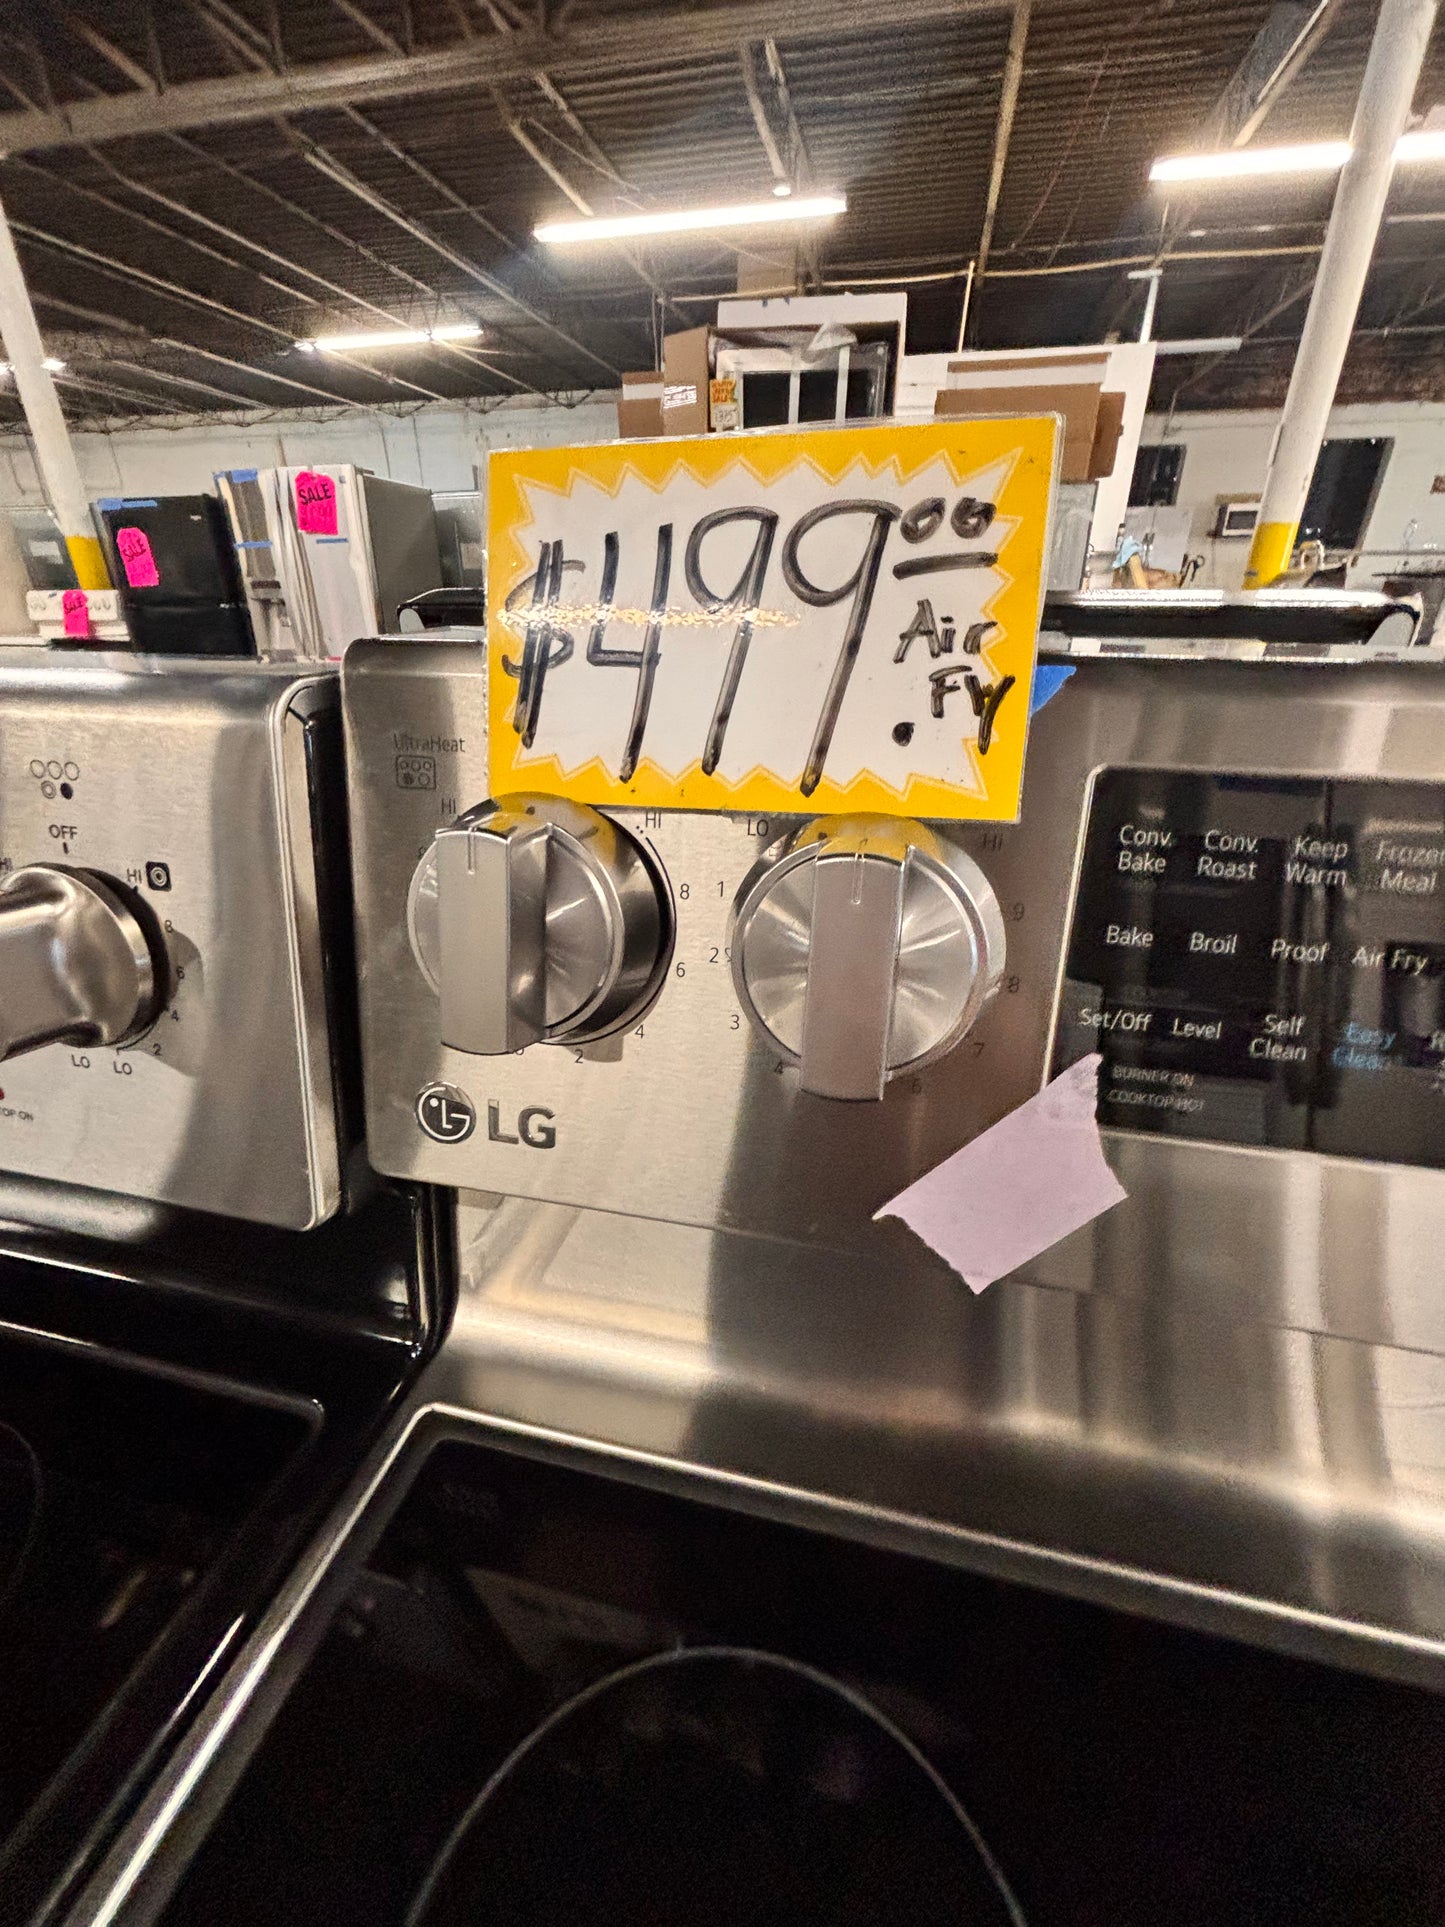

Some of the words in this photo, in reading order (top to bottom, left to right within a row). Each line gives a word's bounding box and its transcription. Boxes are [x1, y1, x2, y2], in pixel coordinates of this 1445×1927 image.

[299, 483, 333, 506] SALE
[122, 540, 147, 563] SALE
[893, 599, 998, 664] Air
[393, 733, 466, 753] UltraHeat
[441, 797, 457, 815] HI
[645, 812, 661, 828] HI
[746, 819, 769, 838] LO
[48, 823, 77, 840] OFF
[1295, 837, 1348, 862] Keep
[1117, 852, 1167, 873] Bake
[1197, 856, 1258, 881] Roast
[126, 868, 143, 884] HI
[1284, 864, 1347, 887] Warm
[1380, 869, 1437, 892] Meal
[678, 883, 690, 900] 8
[717, 880, 725, 898] 1
[1013, 904, 1025, 921] 9
[1106, 925, 1154, 948] Bake
[1190, 932, 1237, 954] Broil
[709, 947, 719, 963] 2
[1270, 938, 1329, 963] Proof
[1351, 946, 1385, 968] Air
[1391, 948, 1429, 975] Fry
[675, 961, 686, 978] 6
[1007, 977, 1020, 994] 8
[730, 1014, 741, 1030] 3
[1078, 1008, 1153, 1032] Set/Off
[1172, 1016, 1223, 1040] Level
[1265, 1014, 1305, 1036] Self
[635, 1024, 645, 1039] 4
[152, 1043, 163, 1056] 2
[574, 1049, 584, 1064] 2
[1250, 1039, 1307, 1062] Clean
[71, 1053, 91, 1069] LO
[113, 1061, 133, 1076] LO
[487, 1099, 556, 1149] LG
